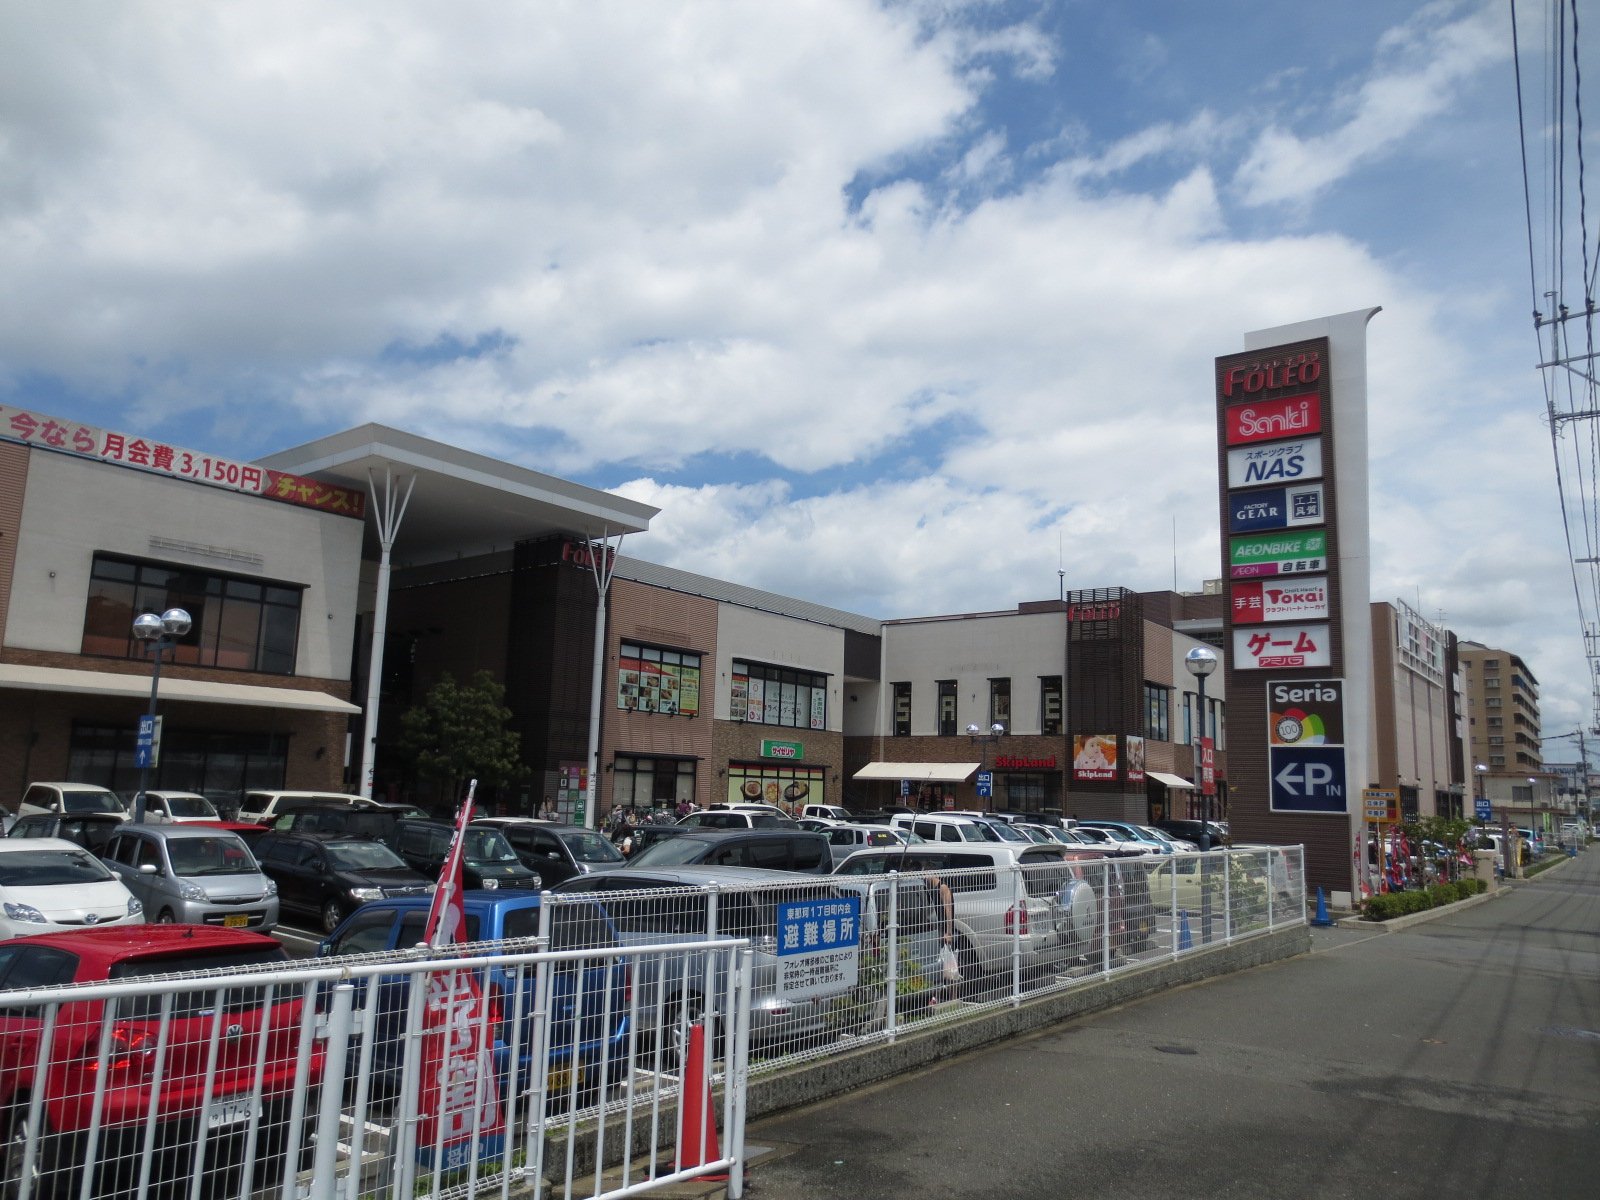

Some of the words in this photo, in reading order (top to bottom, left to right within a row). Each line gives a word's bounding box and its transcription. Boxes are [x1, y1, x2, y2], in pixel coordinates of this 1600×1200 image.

[1223, 361, 1321, 397] FOLEO
[1239, 402, 1309, 436] Sanki
[10, 412, 95, 453] 今なら
[1244, 444, 1303, 460] スポーツクラブ
[1245, 455, 1304, 482] NAS
[1236, 507, 1278, 520] GEAR
[1243, 502, 1268, 510] FACTORY
[1235, 541, 1301, 557] AEONBIKE
[1282, 559, 1320, 572] 自転車
[1234, 597, 1261, 609] 手芸
[1265, 588, 1324, 604] Tokai
[1247, 631, 1318, 656] ゲーム
[1275, 683, 1337, 703] Seria
[140, 720, 152, 734] 出口
[1280, 724, 1298, 736] 100
[771, 746, 796, 757] サイゼリヤ
[1203, 748, 1213, 762] 入口
[1077, 770, 1113, 779] SkipLand
[1305, 762, 1332, 796] P
[1325, 784, 1342, 797] IN
[783, 917, 854, 949] 避難場所
